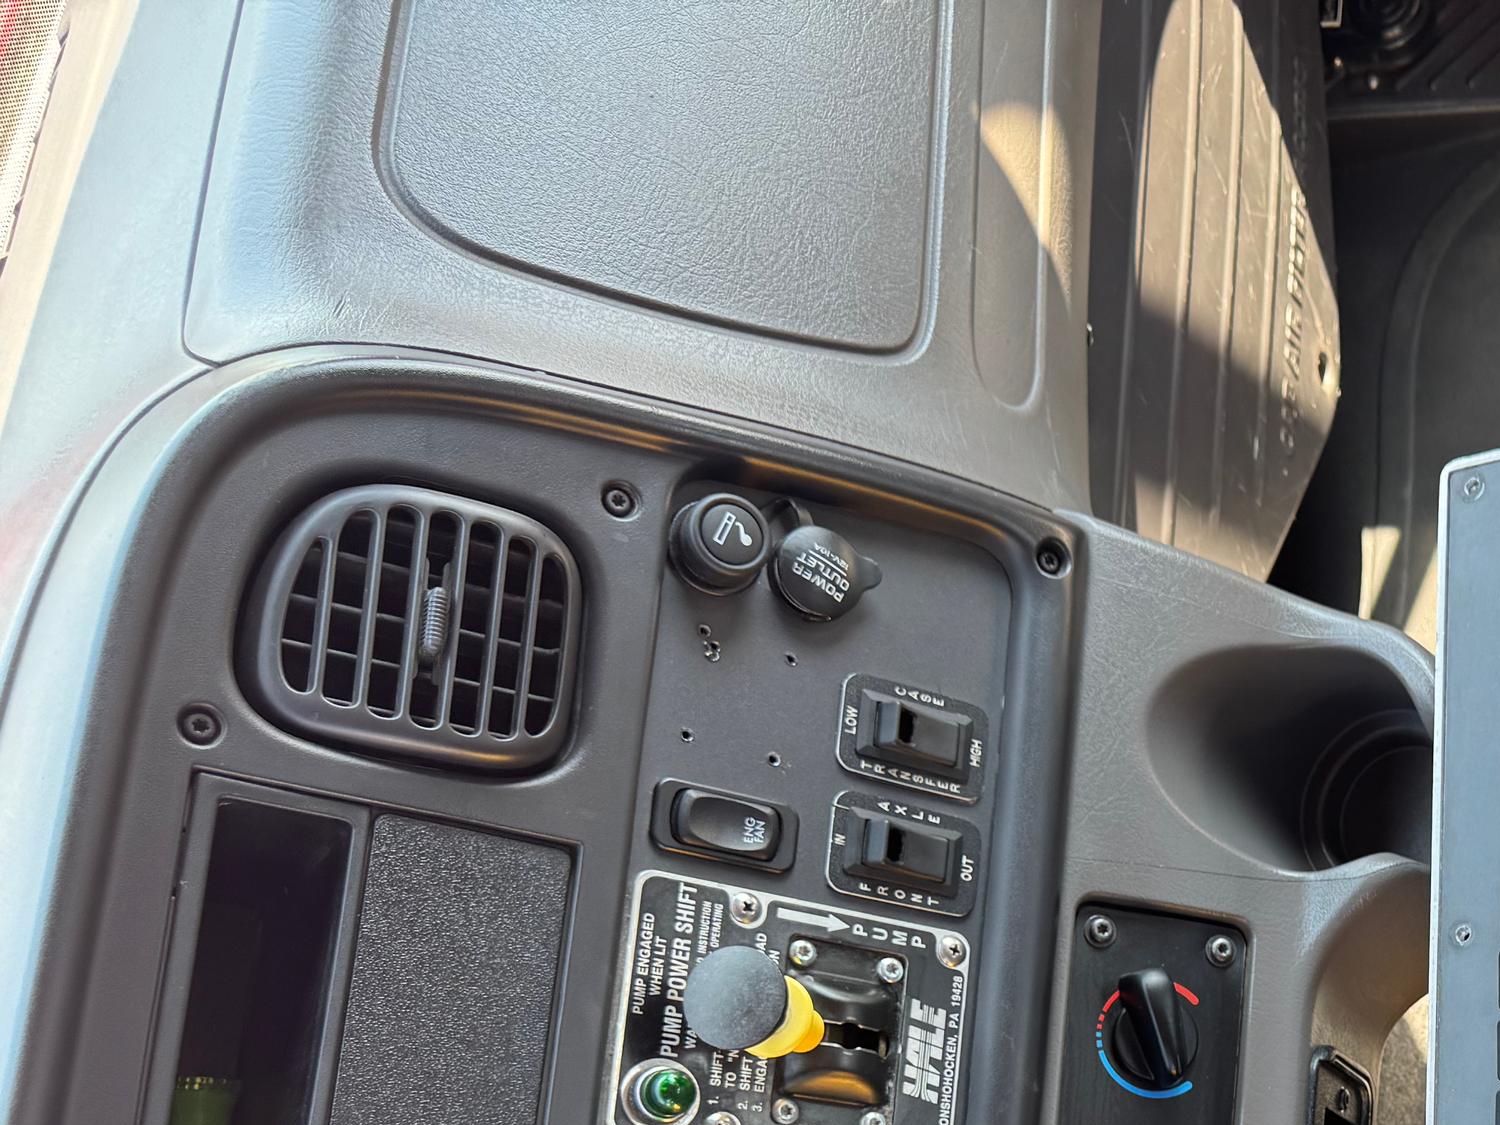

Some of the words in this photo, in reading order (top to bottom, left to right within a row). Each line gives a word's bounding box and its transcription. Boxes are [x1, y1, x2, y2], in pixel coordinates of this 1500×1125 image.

[792, 561, 845, 603] POWER
[796, 552, 850, 592] OUTLET
[895, 686, 945, 707] CASE
[844, 705, 859, 735] LOW
[969, 739, 983, 768] HIGH
[860, 760, 961, 794] TRANSFER
[878, 801, 941, 825] AXLE
[743, 816, 756, 844] ENG
[753, 820, 766, 843] FAN
[834, 833, 846, 846] IN
[960, 855, 975, 882] OUT
[674, 881, 698, 934] SHIFT
[859, 882, 940, 906] FRONT
[697, 901, 713, 952] INSTRUCTION
[712, 903, 725, 949] OPERATING
[852, 924, 927, 949] PUMP
[637, 912, 655, 976] ENGAGED
[653, 935, 668, 951] LIT
[649, 953, 665, 997] WHEN
[667, 937, 692, 1001] POWER
[632, 978, 645, 1015] PUMP
[950, 975, 964, 1007] 19428
[660, 1005, 683, 1058] PUMP
[948, 1011, 961, 1029] PA
[902, 998, 947, 1105] HALE
[738, 1056, 754, 1091] SHIFT
